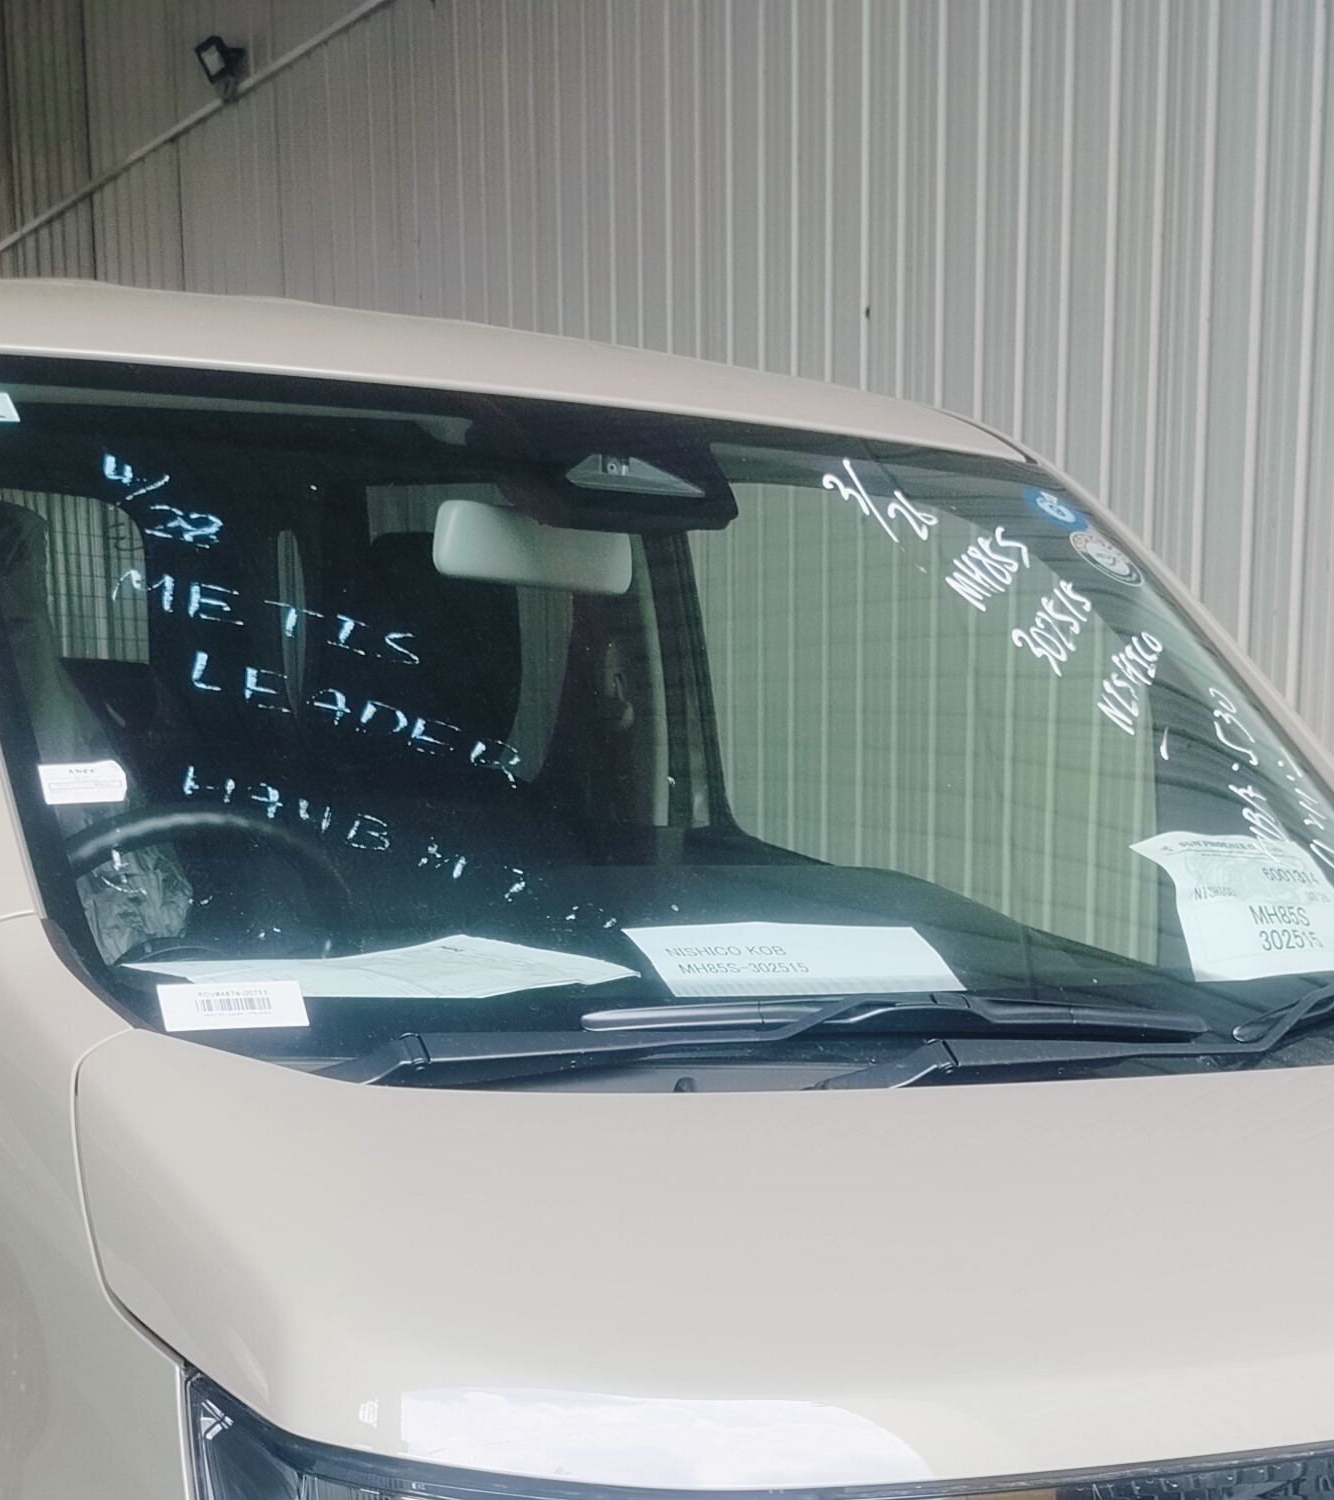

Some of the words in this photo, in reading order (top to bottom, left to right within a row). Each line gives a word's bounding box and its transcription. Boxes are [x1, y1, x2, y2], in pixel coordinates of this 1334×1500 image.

[1248, 905, 1310, 927] MH85S
[1259, 929, 1324, 951] 302515
[665, 945, 742, 957] NISHICO
[746, 945, 787, 956] KOB
[677, 962, 810, 975] MH85S-302515
